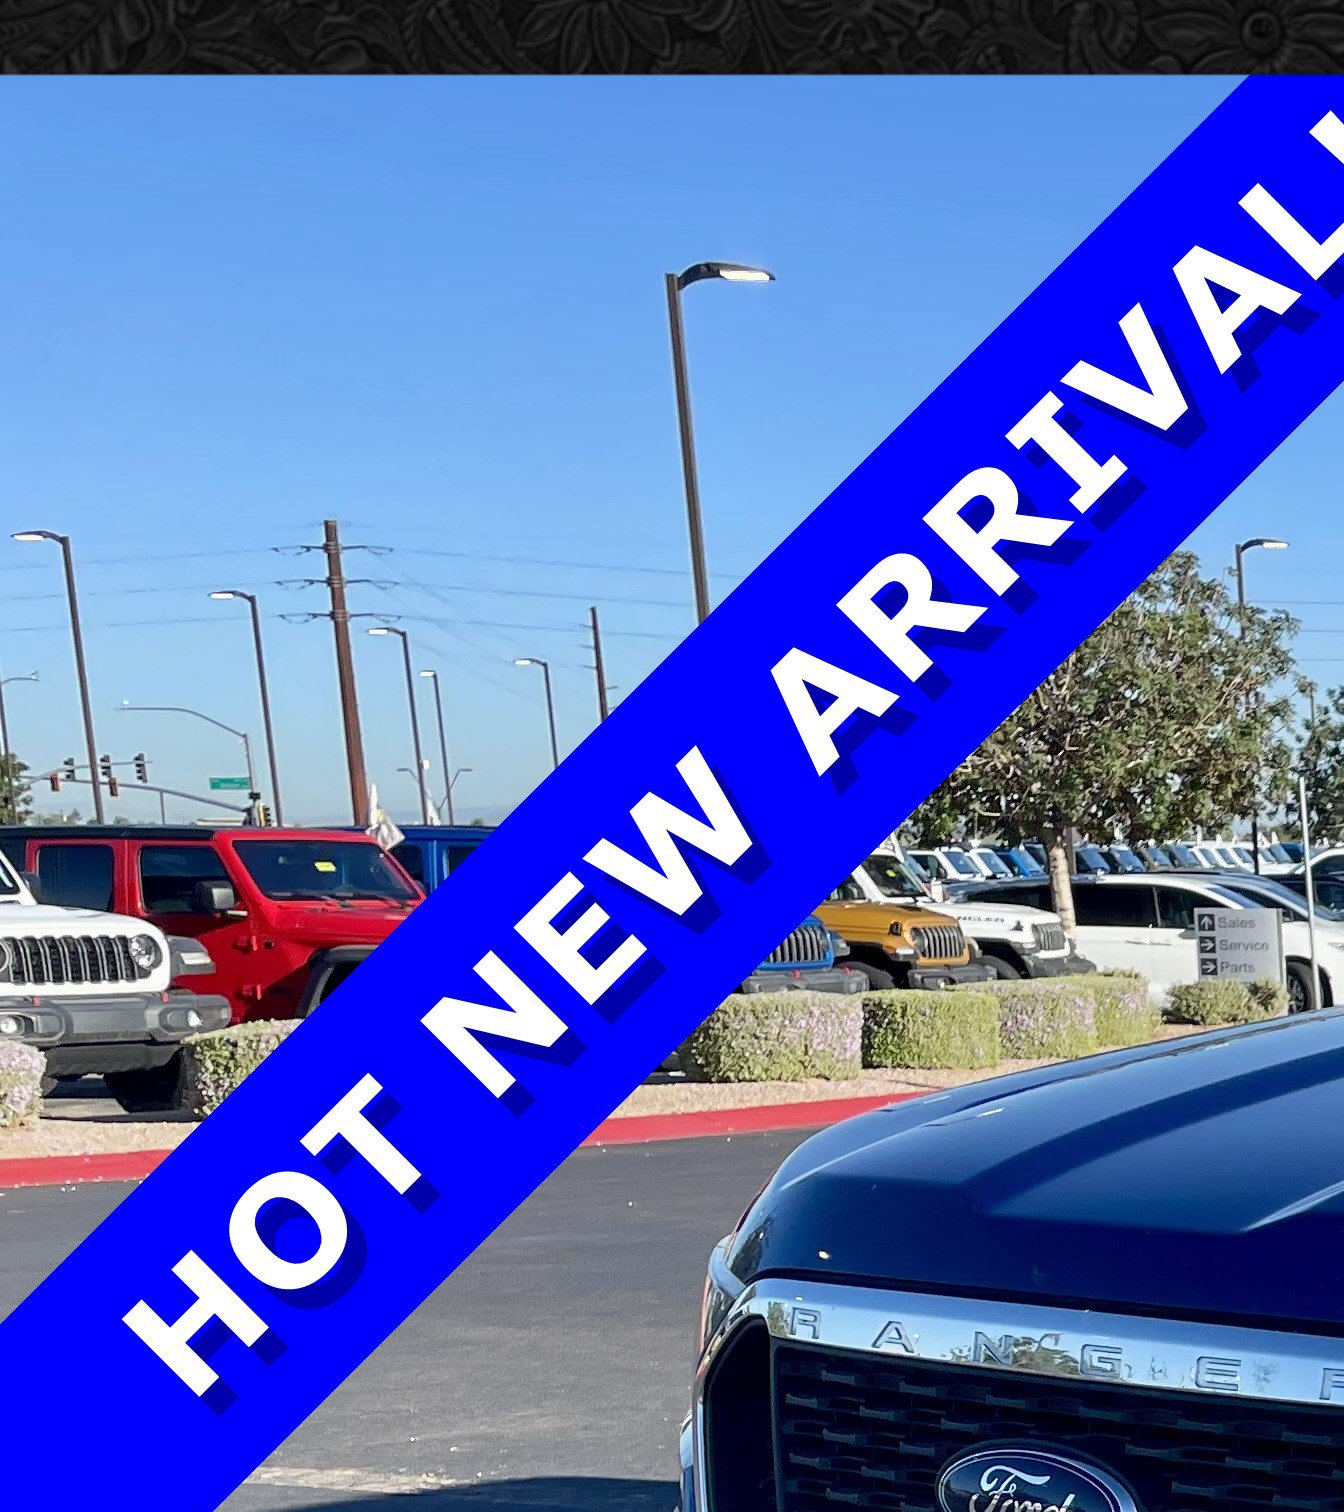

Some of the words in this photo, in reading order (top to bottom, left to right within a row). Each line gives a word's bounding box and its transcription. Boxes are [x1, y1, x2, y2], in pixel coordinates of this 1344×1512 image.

[1217, 916, 1257, 929] Sales
[1218, 939, 1270, 952] Service
[1219, 961, 1256, 974] Parts
